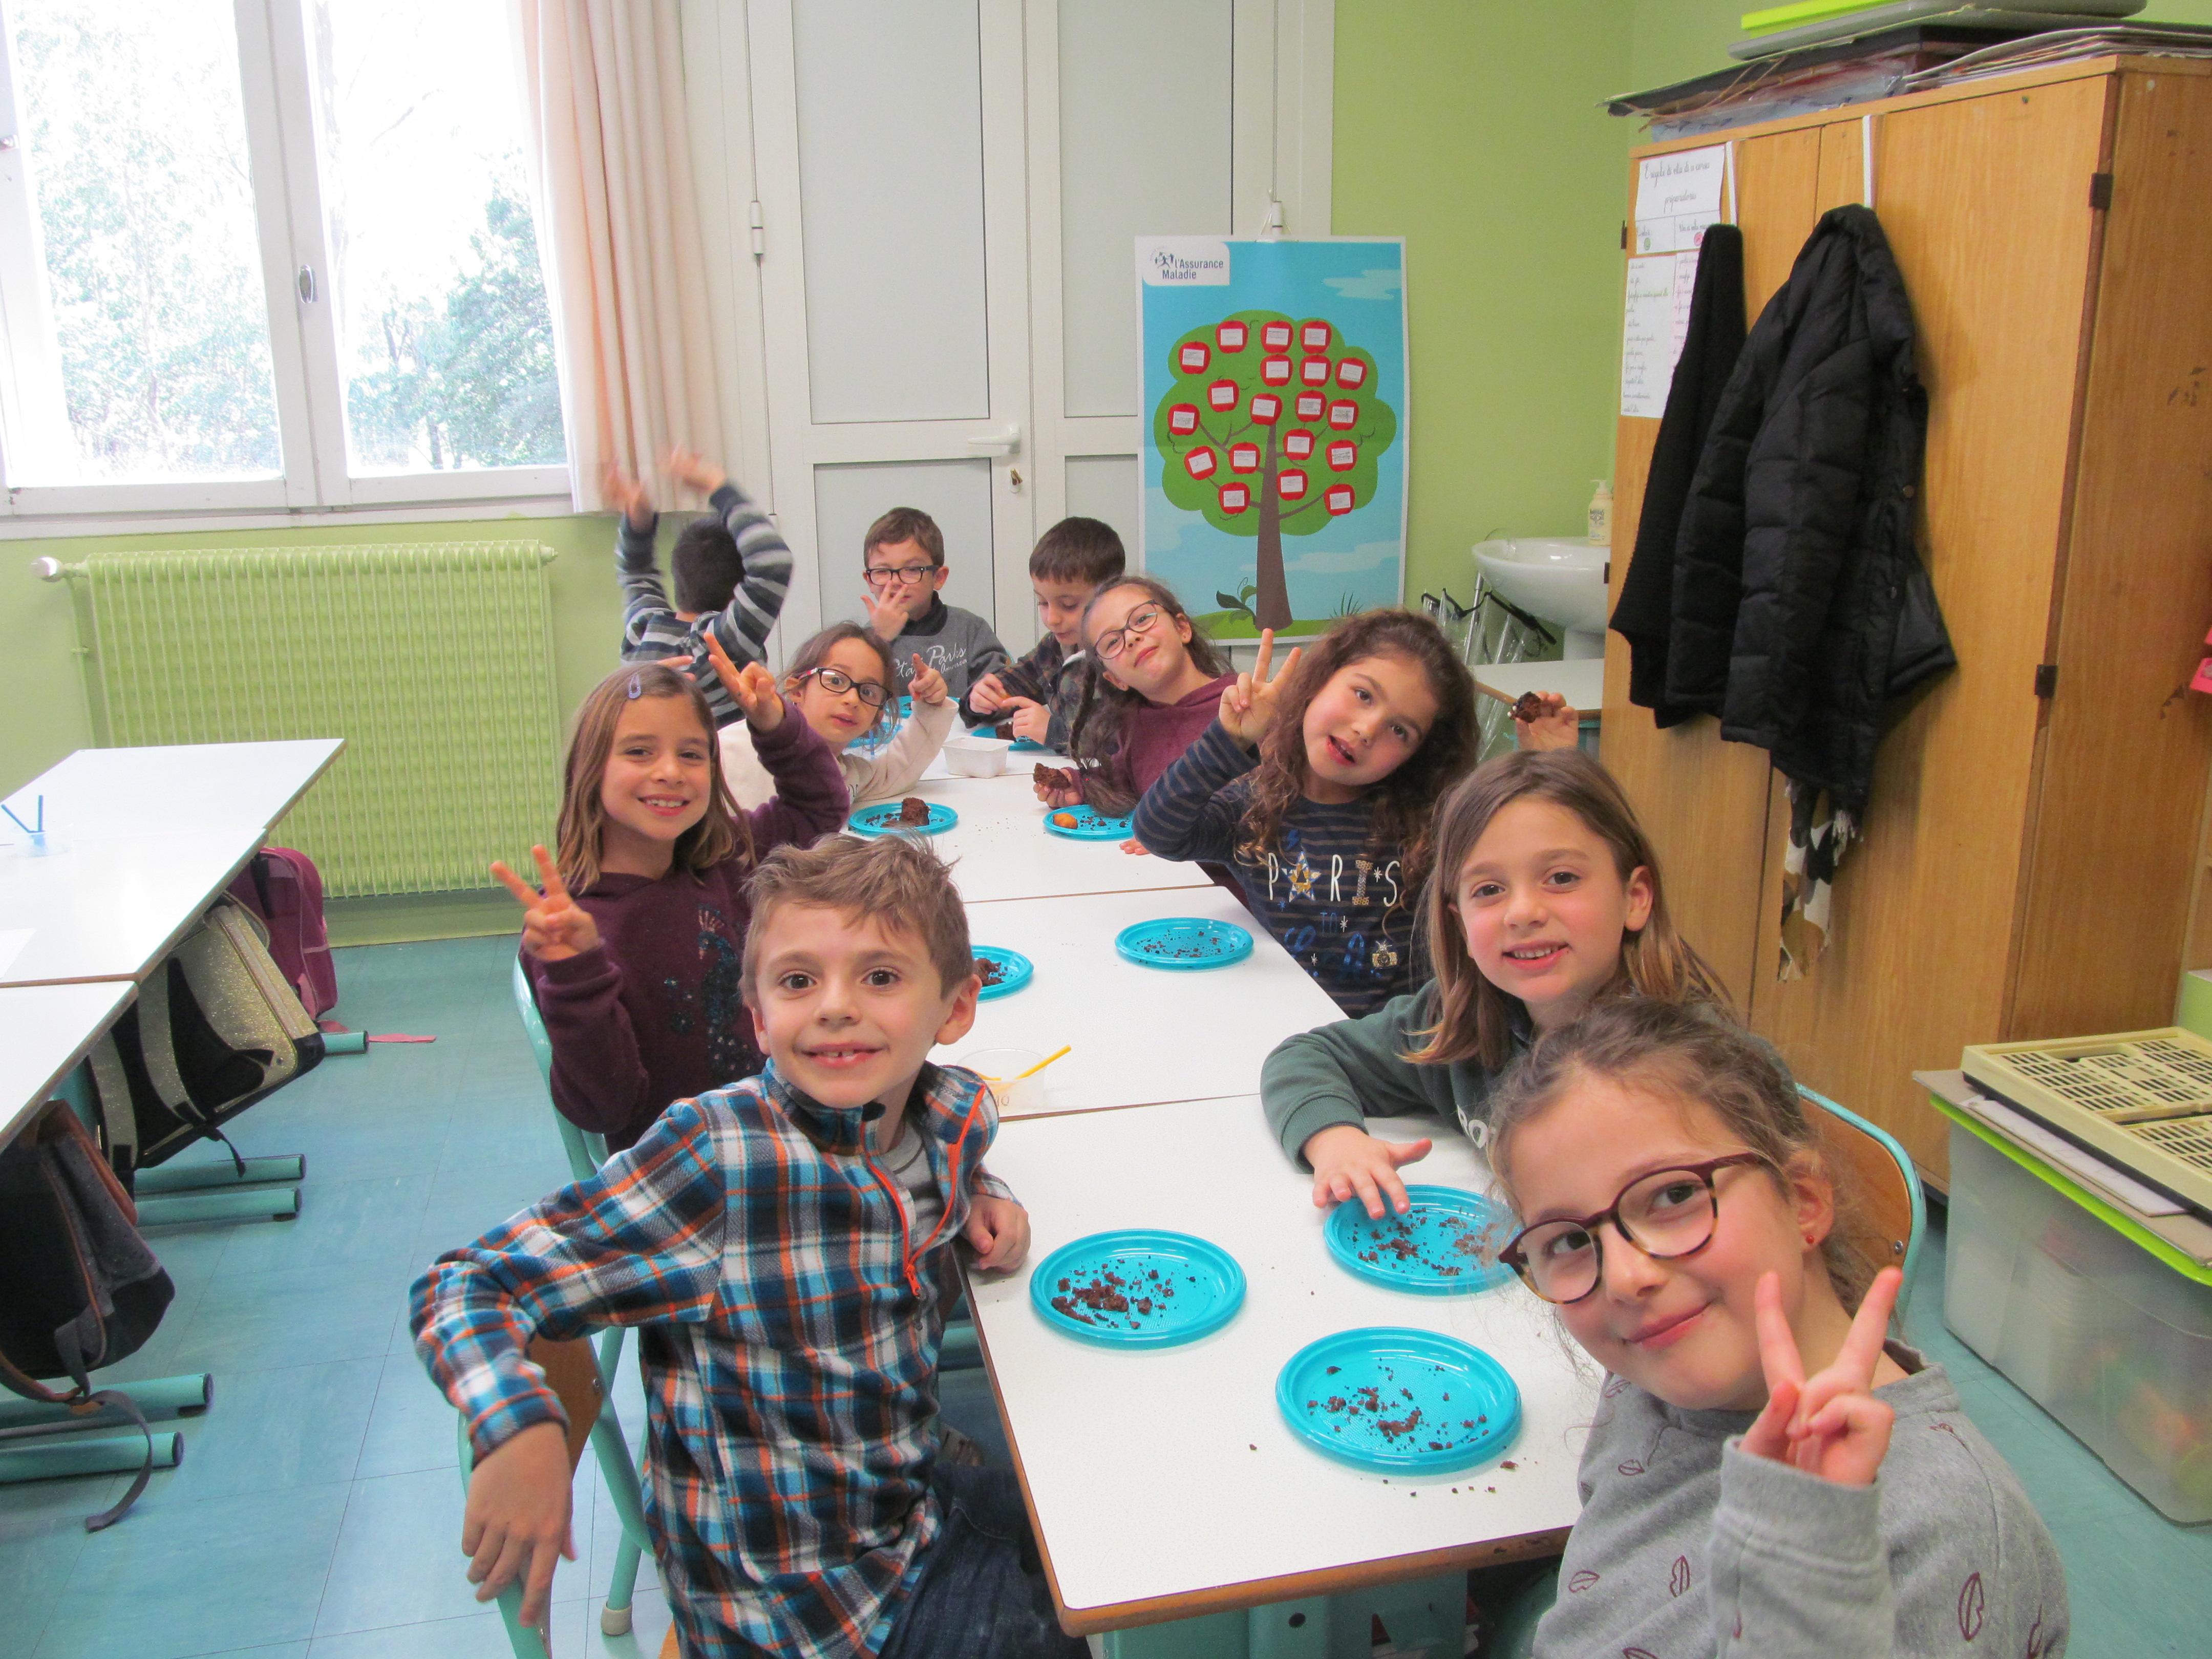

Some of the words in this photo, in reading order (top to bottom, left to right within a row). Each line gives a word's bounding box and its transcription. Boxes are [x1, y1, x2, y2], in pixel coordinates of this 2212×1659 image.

[1175, 258, 1224, 269] l'Assurance
[1162, 269, 1197, 280] Maladie
[926, 643, 966, 668] Paris
